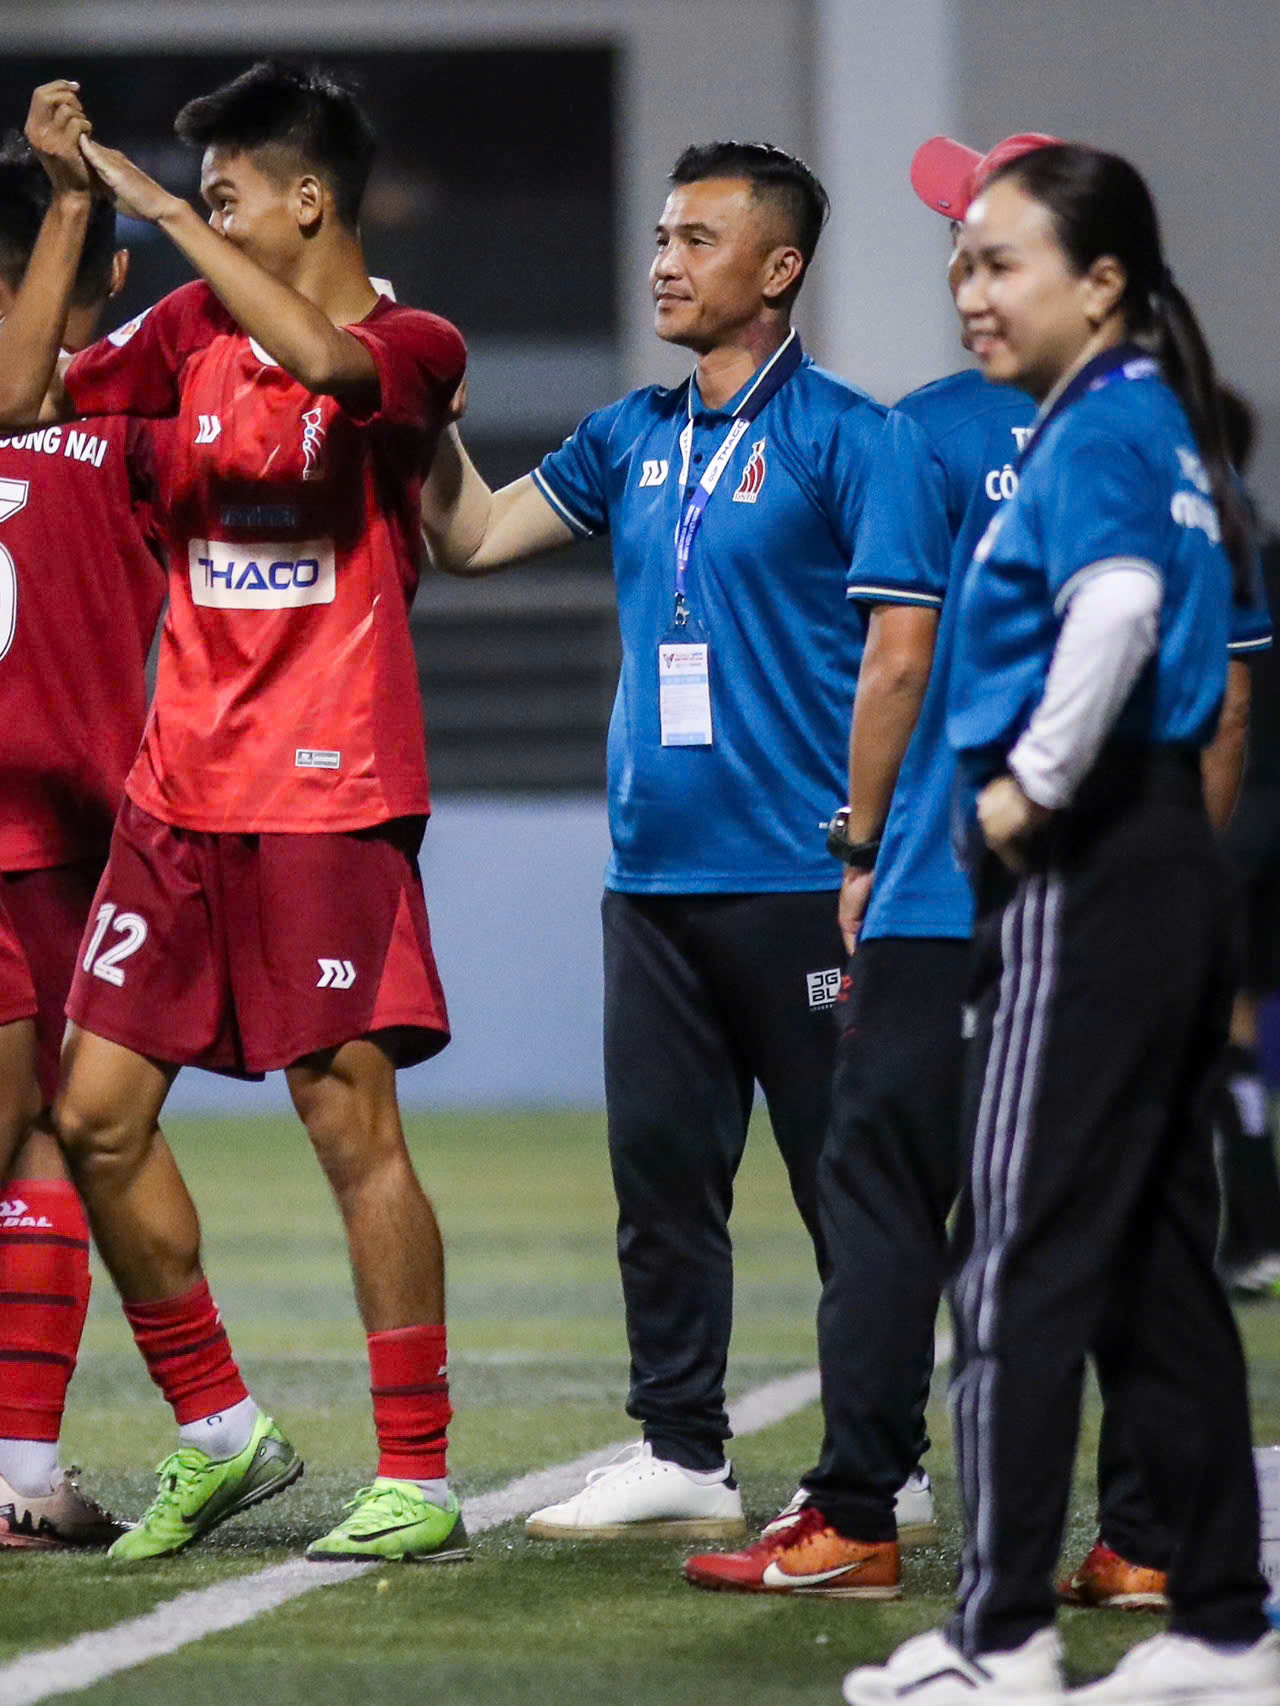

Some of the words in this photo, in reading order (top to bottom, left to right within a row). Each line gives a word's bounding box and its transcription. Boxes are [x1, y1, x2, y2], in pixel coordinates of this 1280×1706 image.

[64, 430, 108, 468] NAI
[198, 558, 319, 590] THACO
[82, 903, 148, 988] 12
